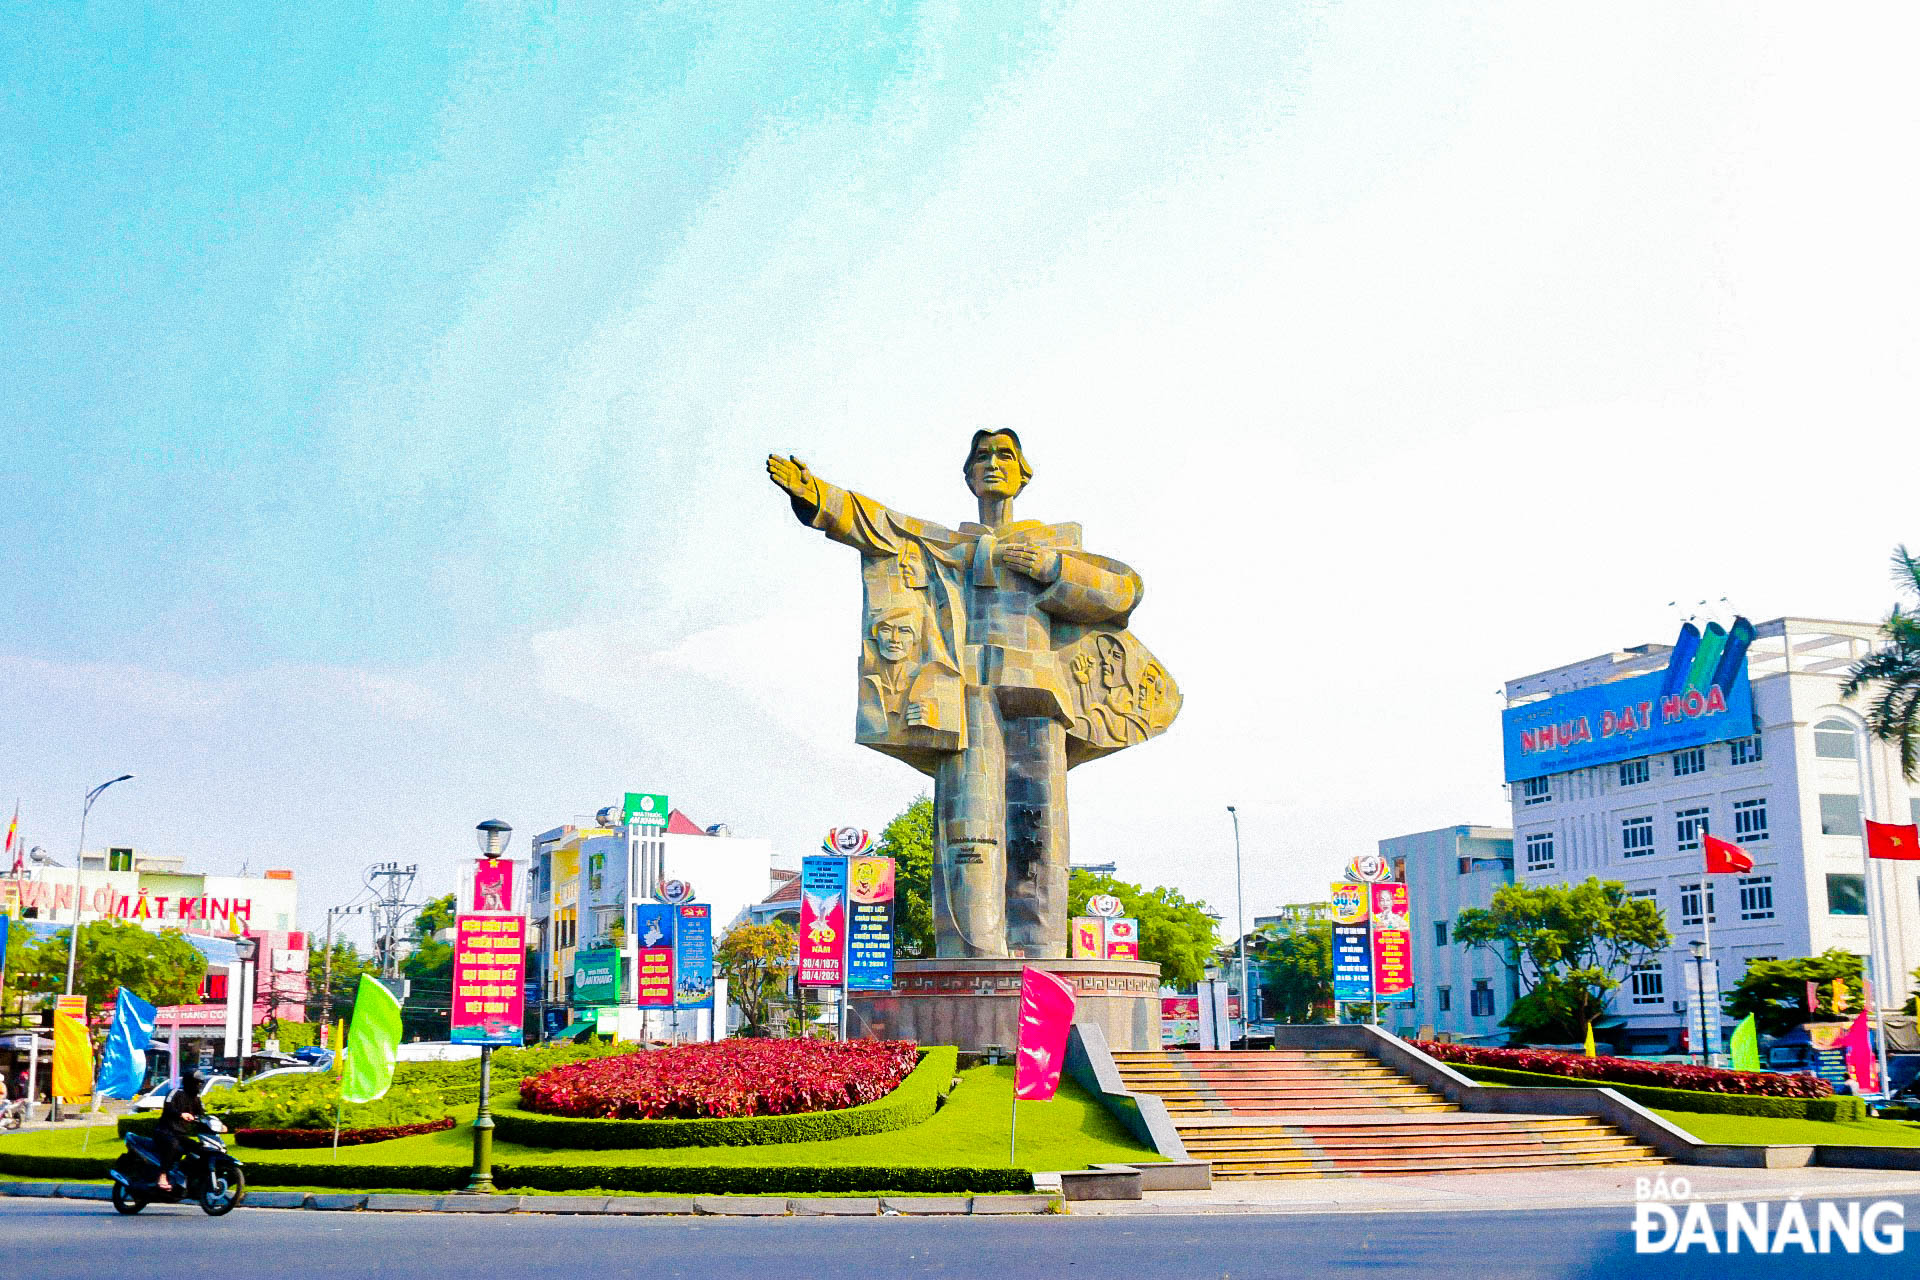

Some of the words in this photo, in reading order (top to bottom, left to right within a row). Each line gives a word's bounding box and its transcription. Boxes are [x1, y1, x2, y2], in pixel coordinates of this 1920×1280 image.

[1599, 701, 1652, 739] ĐẠT
[179, 892, 252, 920] KÍNH
[808, 929, 835, 942] 49
[812, 943, 831, 953] NĂM
[802, 958, 838, 969] 30/4/1975
[802, 970, 840, 980] 30/4/2024
